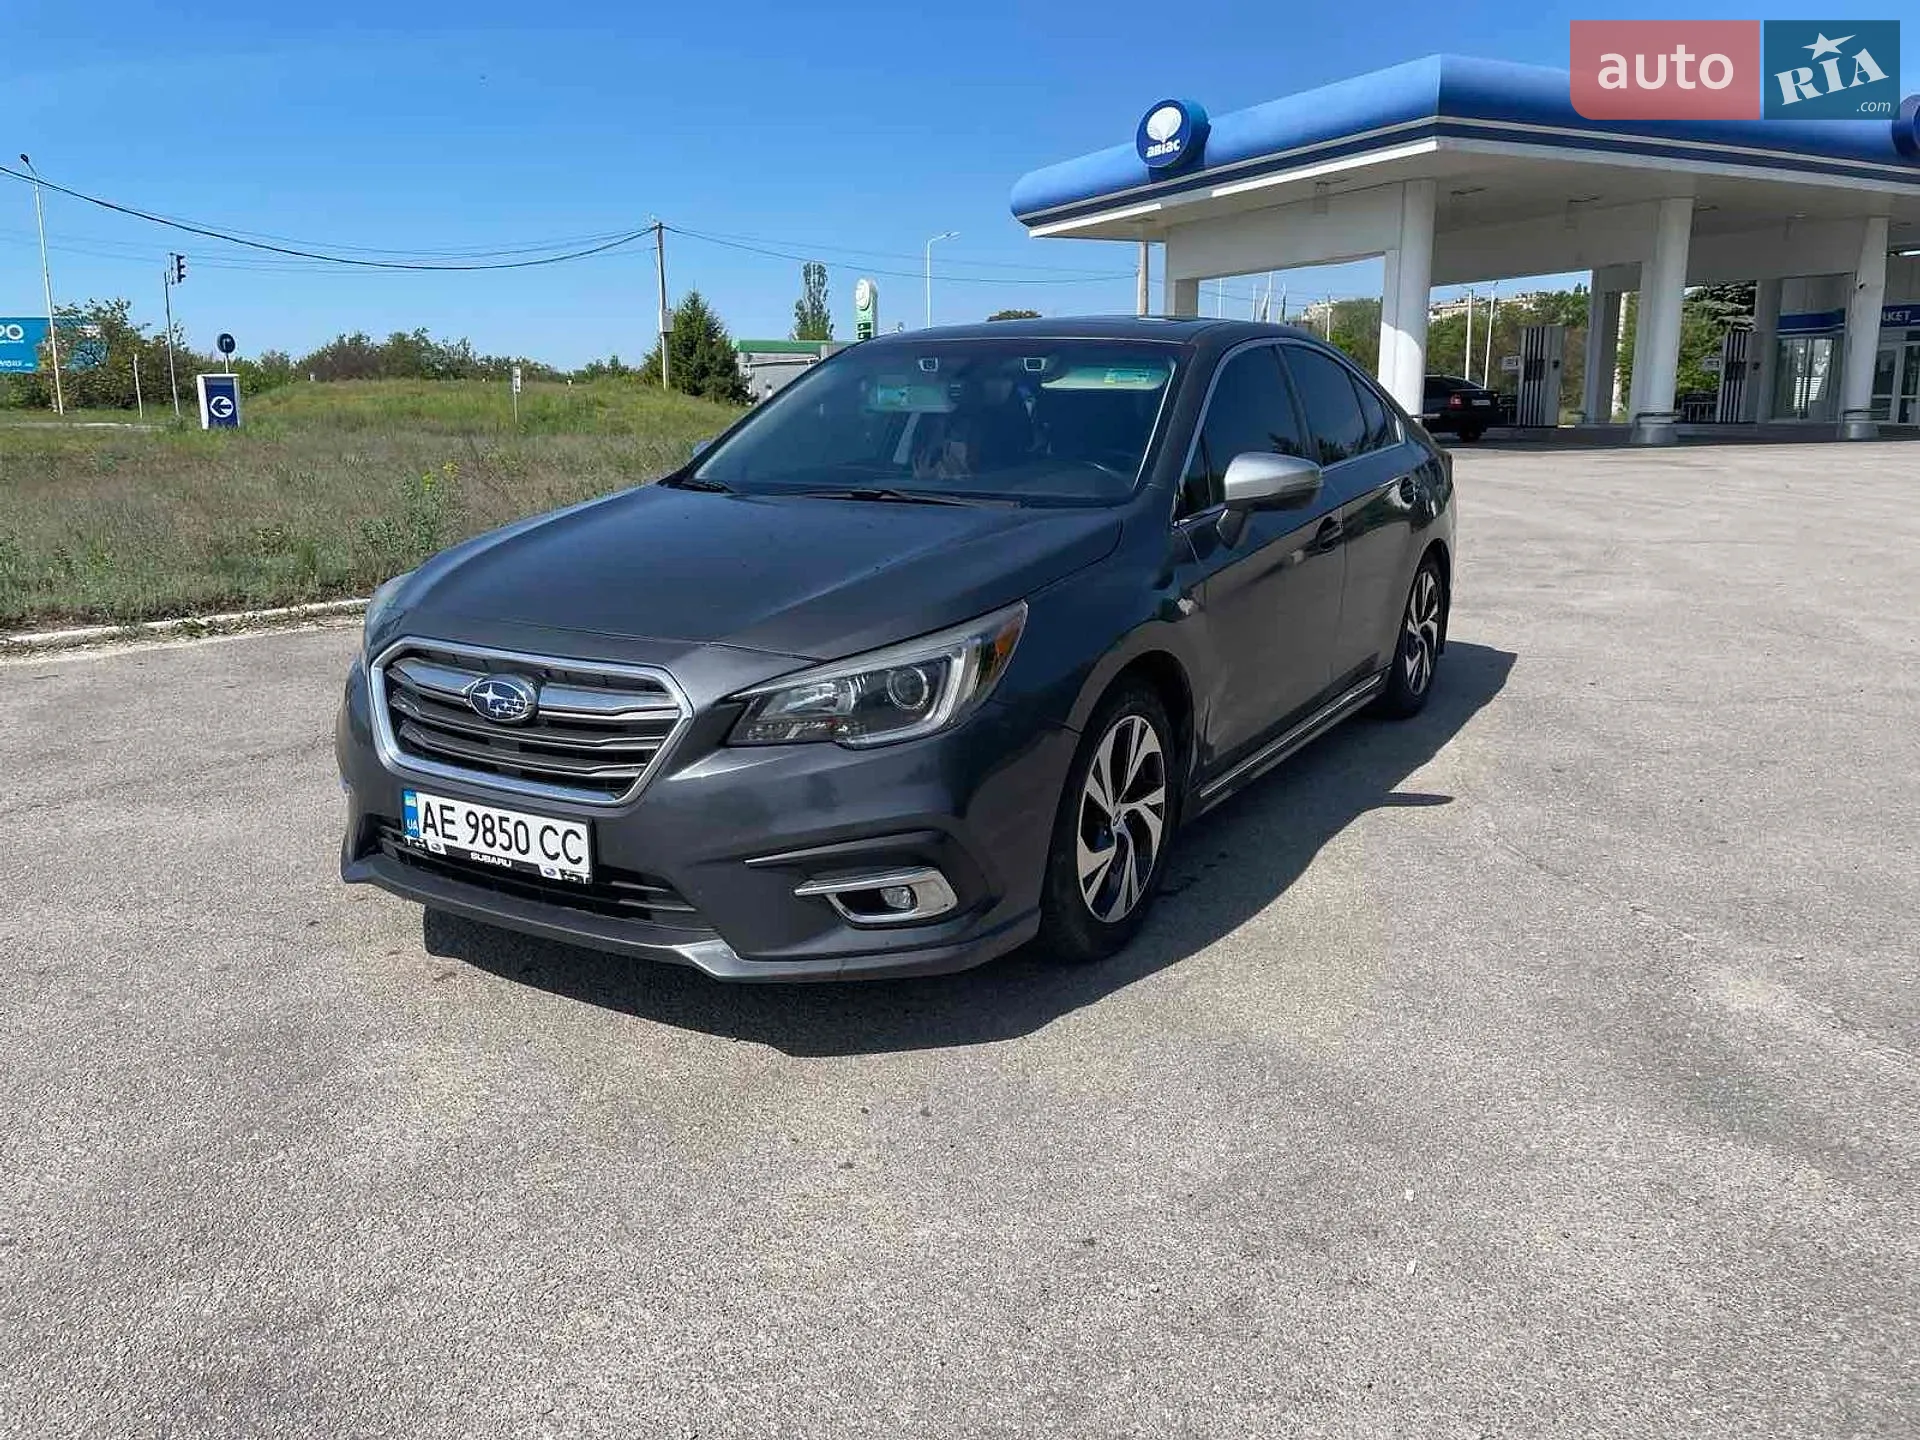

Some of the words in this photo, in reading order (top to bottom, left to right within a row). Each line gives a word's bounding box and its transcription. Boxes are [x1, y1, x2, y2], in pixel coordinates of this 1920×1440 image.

[406, 818, 418, 831] UA
[422, 800, 458, 841] AE
[465, 810, 530, 855] 9850
[539, 824, 583, 865] CC
[470, 851, 512, 868] SUBARU
